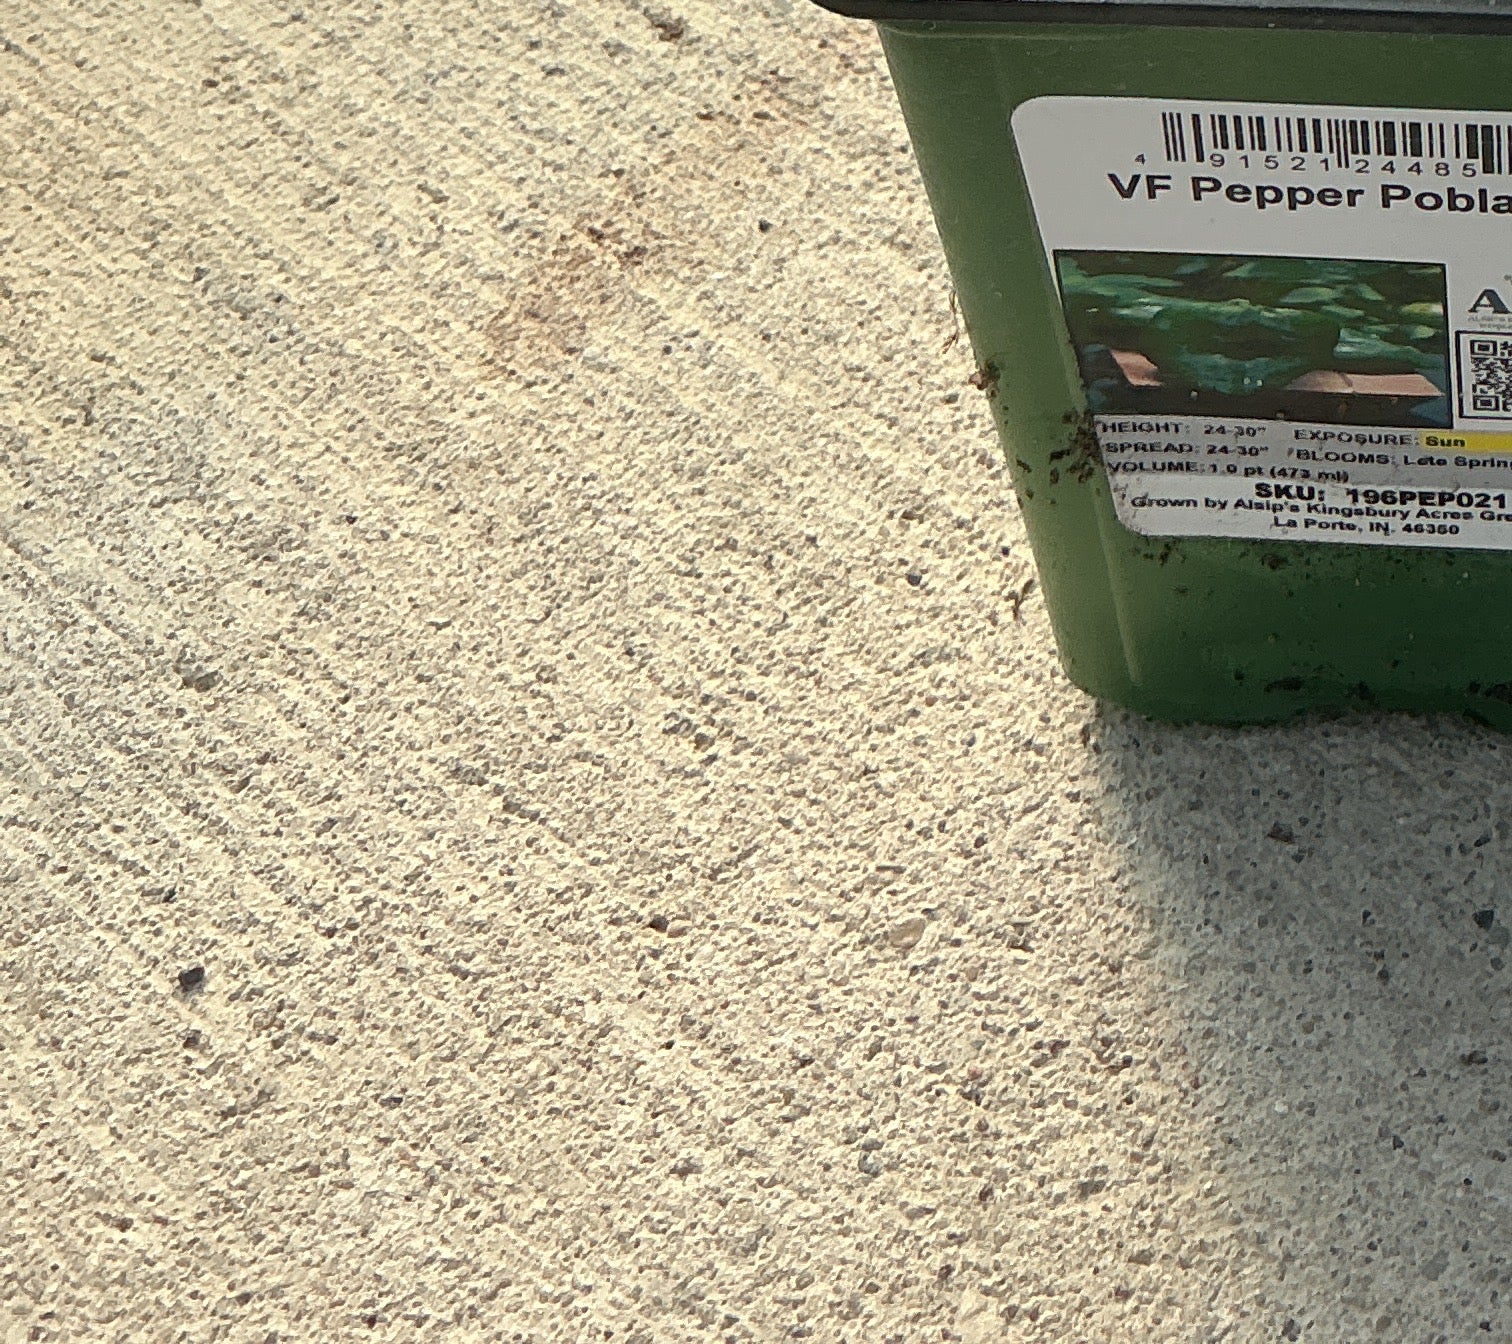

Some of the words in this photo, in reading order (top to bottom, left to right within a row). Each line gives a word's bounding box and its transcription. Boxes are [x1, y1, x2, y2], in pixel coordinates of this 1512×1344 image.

[1107, 172, 1172, 200] VF
[1191, 176, 1365, 211] Pepper
[1101, 421, 1190, 435] HEIGHT:
[1293, 428, 1419, 446] EXPOSURE:
[1424, 435, 1466, 448] Sun
[1104, 441, 1200, 455] SPREAD:
[1296, 448, 1396, 465] BLOOMS:
[1403, 454, 1448, 467] Late
[1107, 461, 1205, 474] VOLUME:
[1243, 464, 1264, 478] pt
[1269, 465, 1311, 480] (473
[1130, 495, 1199, 509] Grown
[1204, 497, 1229, 511] by
[1233, 498, 1301, 514] Alsip's
[1306, 503, 1411, 521] Kingsbury
[1415, 507, 1475, 521] Acres
[1254, 482, 1326, 502] SKU:
[1346, 488, 1506, 509] 196PEP021
[1273, 515, 1298, 529] La
[1304, 517, 1363, 533] Porte,
[1401, 522, 1460, 536] 46350
